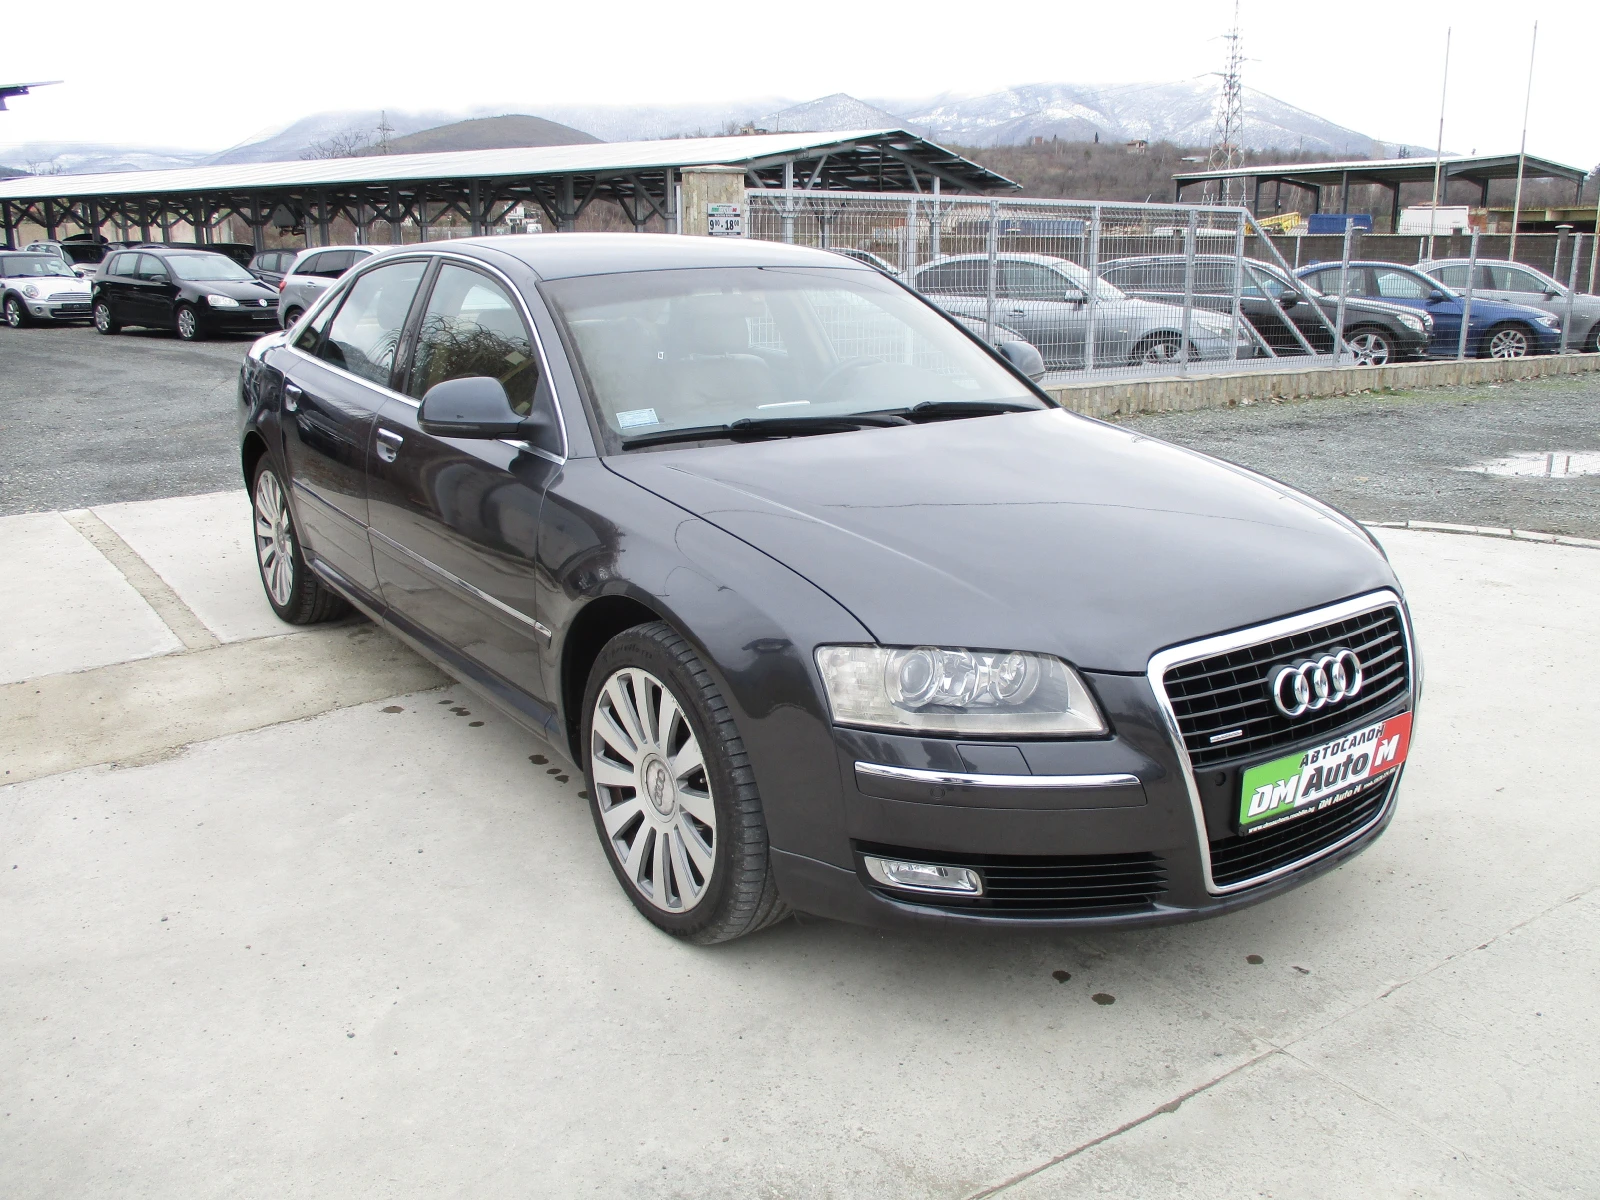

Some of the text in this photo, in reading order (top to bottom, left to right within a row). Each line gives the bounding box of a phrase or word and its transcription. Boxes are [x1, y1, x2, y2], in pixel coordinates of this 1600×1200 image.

[1299, 723, 1386, 769] АВТОСАЛОН
[1247, 775, 1301, 818] DM
[1301, 752, 1370, 798] Auto
[1374, 733, 1400, 767] M
[1332, 789, 1353, 804] Auto
